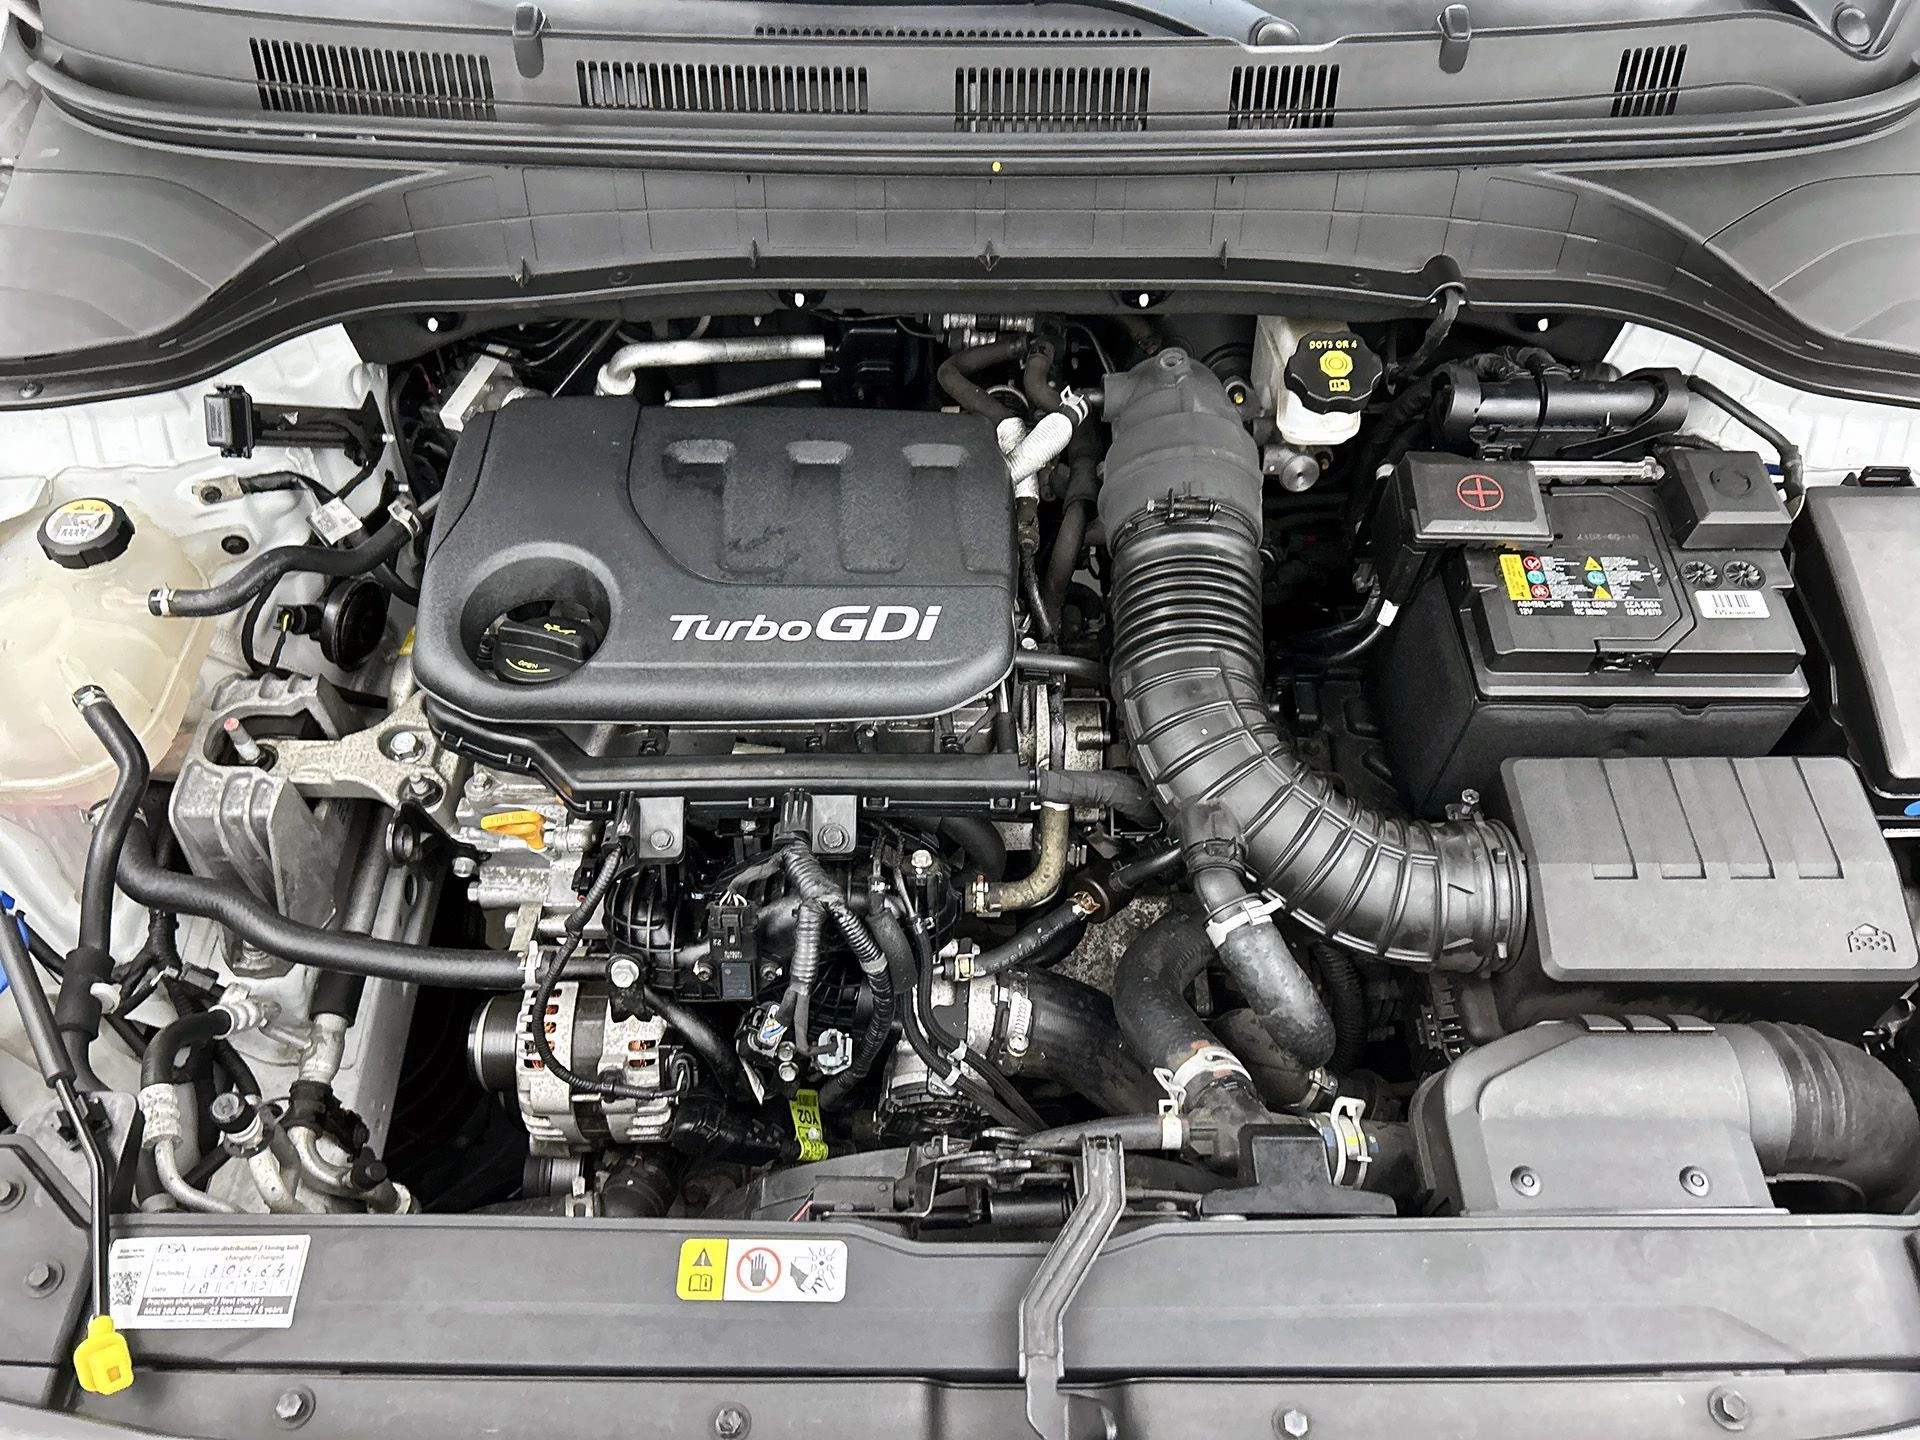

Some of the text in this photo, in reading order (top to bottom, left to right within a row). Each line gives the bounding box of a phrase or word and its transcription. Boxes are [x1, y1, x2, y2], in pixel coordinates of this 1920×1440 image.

[1309, 340, 1357, 349] DOT3 OR 4
[1519, 608, 1533, 616] 12V
[517, 660, 538, 669] OPEN
